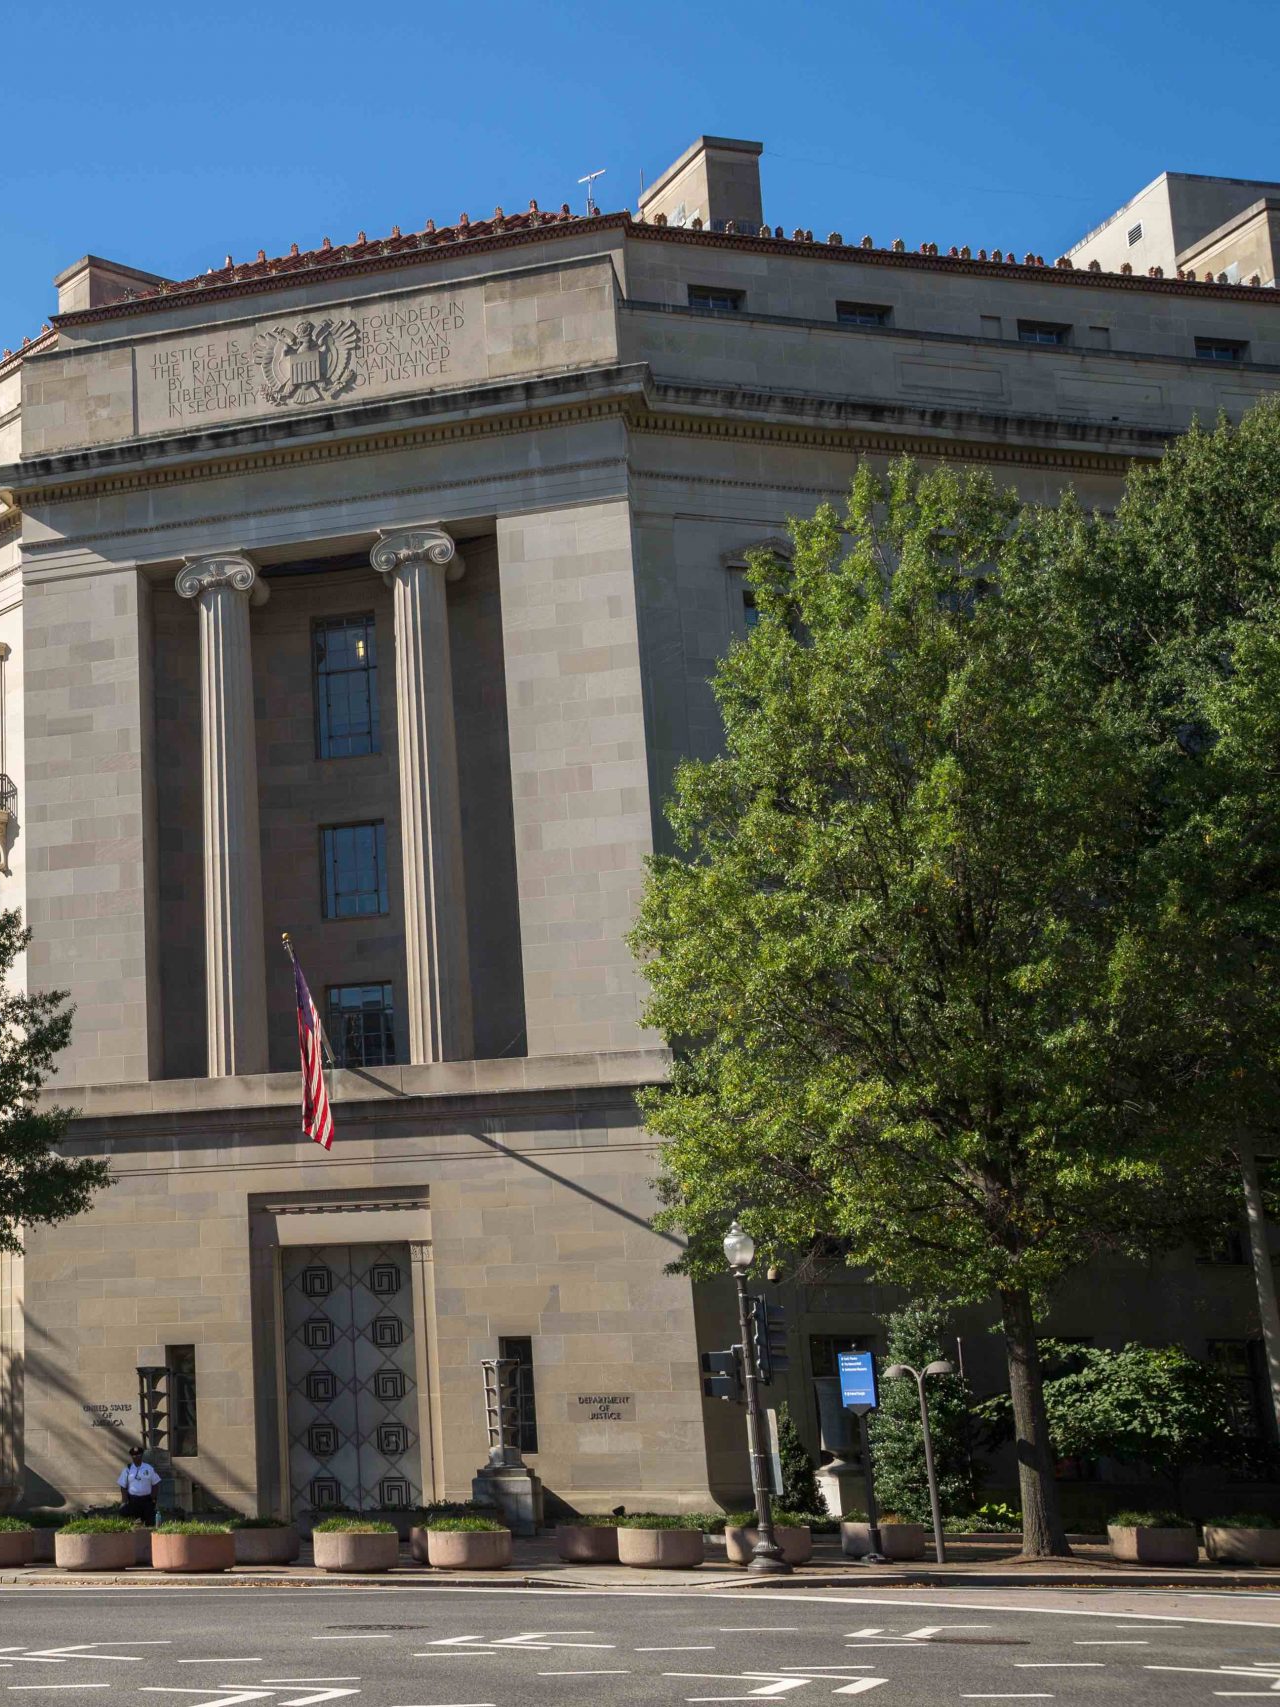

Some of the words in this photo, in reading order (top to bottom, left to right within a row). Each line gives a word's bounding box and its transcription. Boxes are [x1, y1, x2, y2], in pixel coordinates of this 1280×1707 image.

[150, 344, 216, 367] JUSTICE
[226, 340, 239, 354] IS
[362, 306, 440, 330] FOUNDED
[449, 300, 464, 316] IN
[151, 363, 180, 380] THE
[192, 352, 249, 373] RIGHTS
[362, 316, 464, 344] BESTOWED
[168, 376, 184, 390] BY
[193, 364, 255, 386] NATURE
[354, 340, 400, 358] UPON
[168, 382, 230, 404] LIBERTY
[240, 379, 254, 392] IS
[356, 346, 450, 372] MAINTAINED
[168, 404, 182, 418] IN
[188, 390, 259, 414] SECURITY
[354, 372, 374, 386] OF
[83, 1404, 108, 1412] UNITED
[578, 1396, 631, 1404] DEPARTMENT
[589, 1412, 622, 1420] JUSTICE
